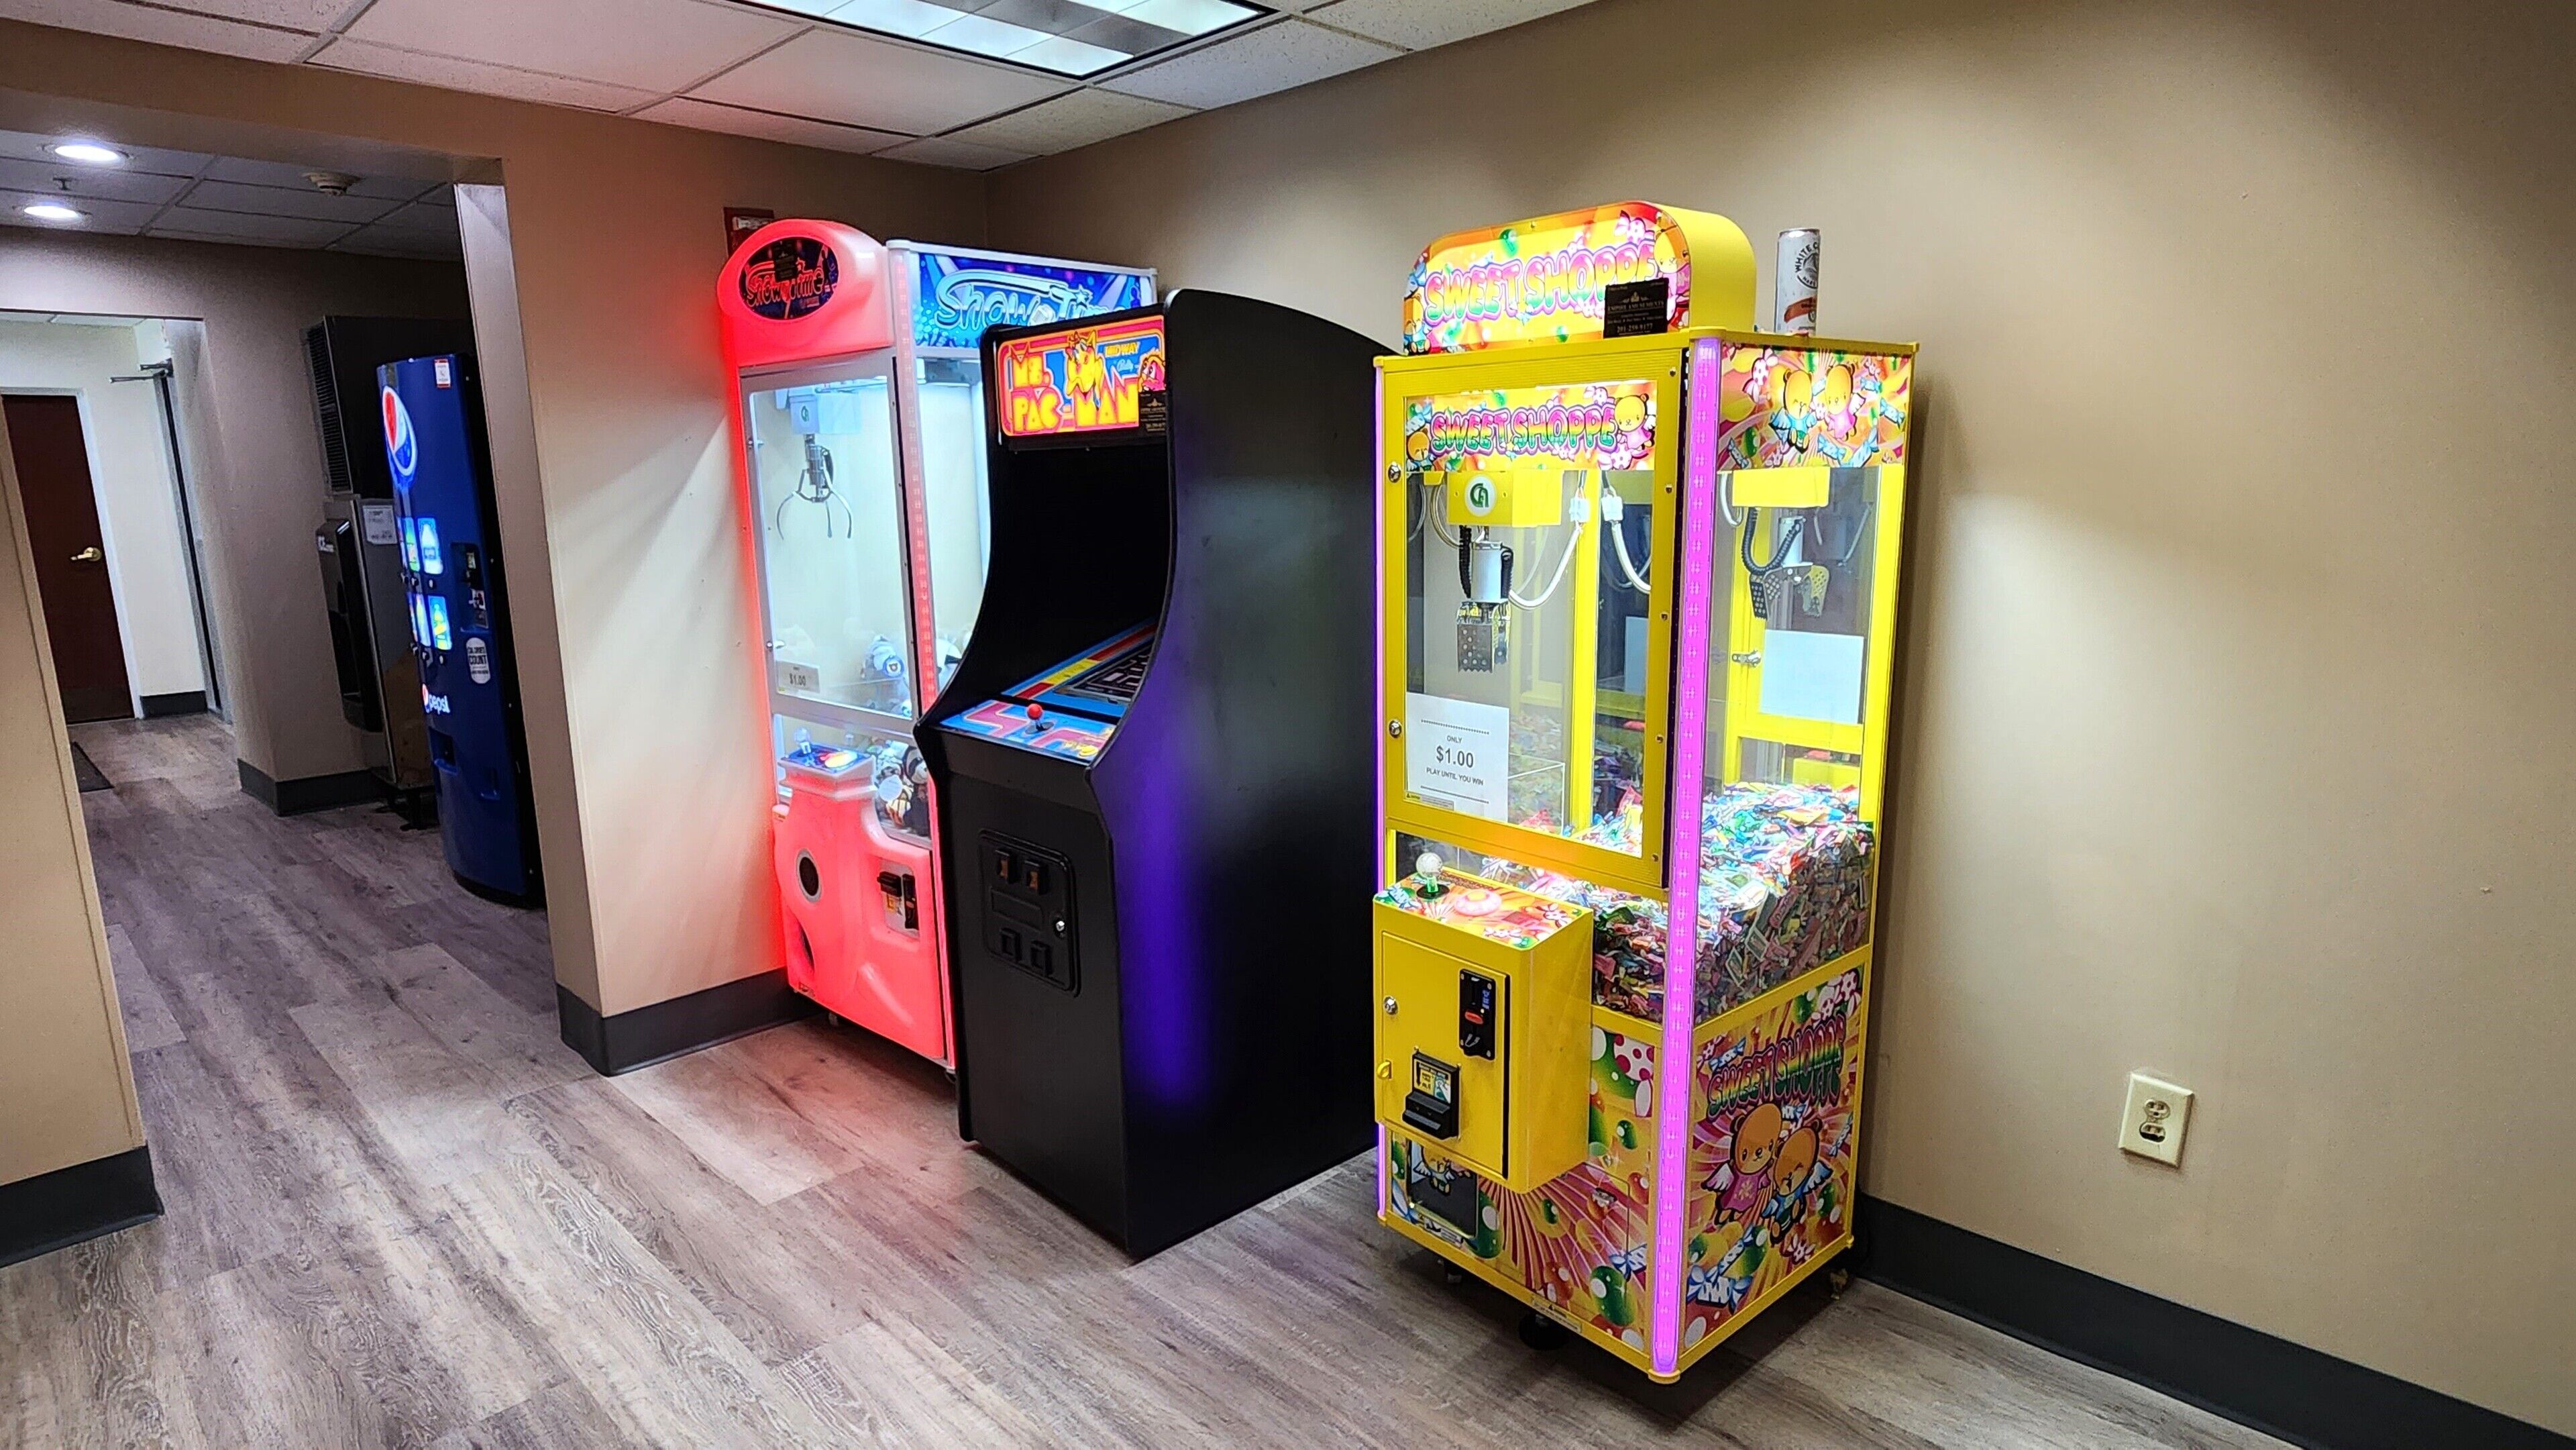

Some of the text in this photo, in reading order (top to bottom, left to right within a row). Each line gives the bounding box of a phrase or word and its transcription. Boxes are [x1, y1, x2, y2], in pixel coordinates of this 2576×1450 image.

[1795, 244, 1812, 273] WHITE
[1424, 240, 1656, 326] SWEET SHOPPE
[1105, 342, 1140, 358] MIDWAY
[1012, 353, 1052, 388] MS.
[1012, 380, 1138, 432] PAC-MAN
[1430, 403, 1617, 456] SWEET SHOPPE
[429, 693, 451, 715] pepsi
[1446, 735, 1462, 743] ONLY
[1436, 745, 1474, 768] $1.00
[1426, 767, 1484, 786] PLAY UNTIL YOU WIN
[1707, 1013, 1845, 1119] SWEET SHOPPE
